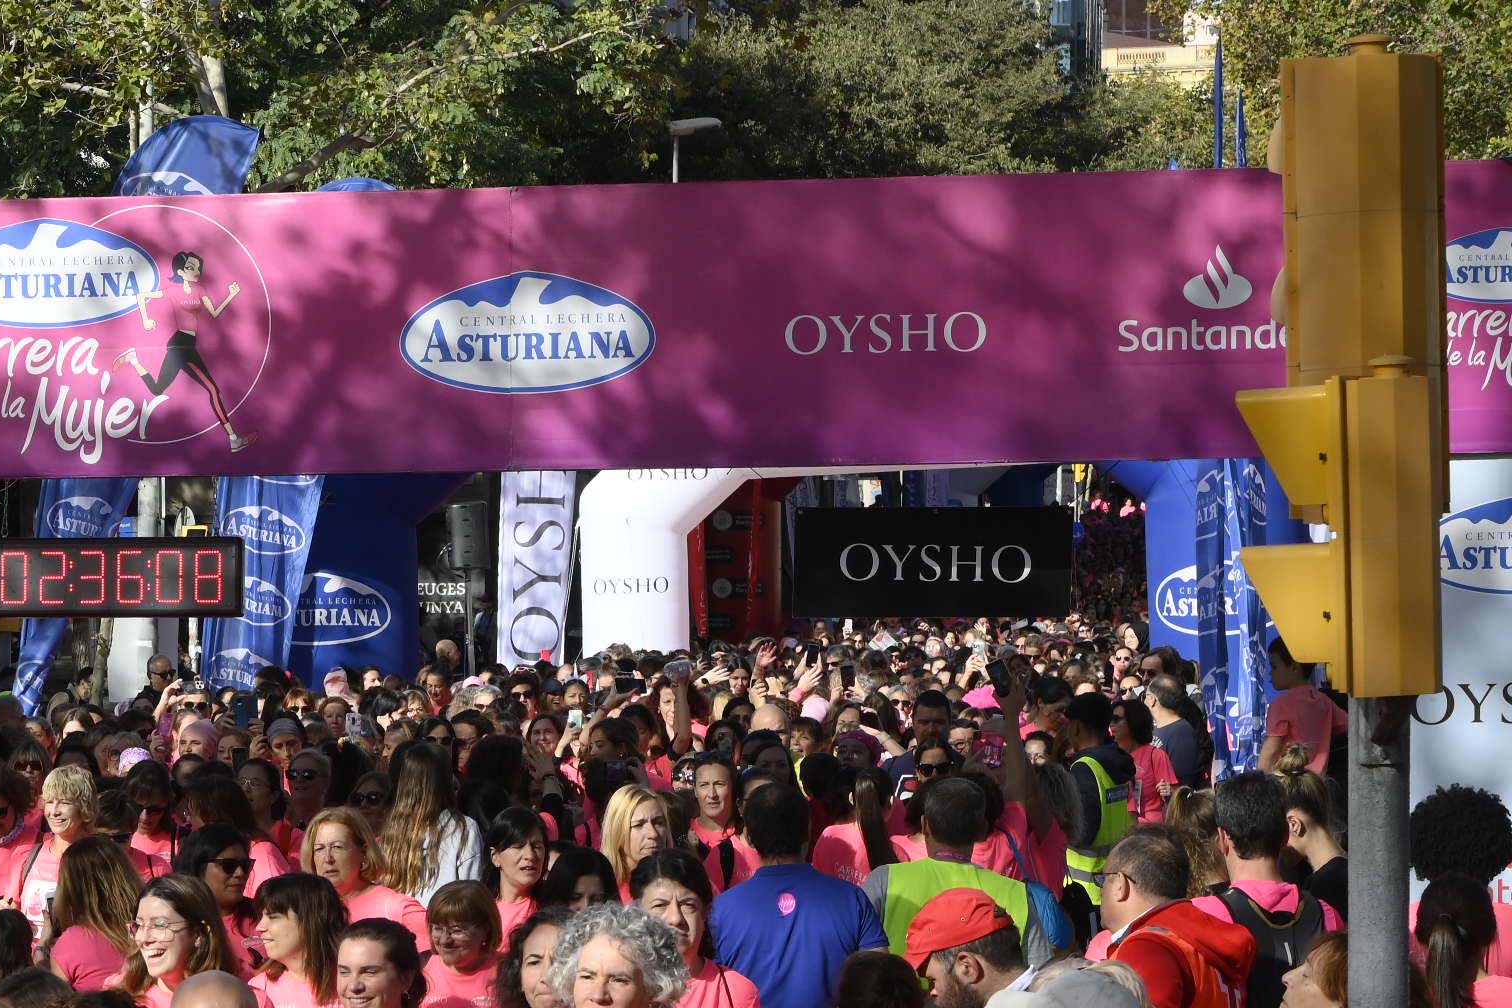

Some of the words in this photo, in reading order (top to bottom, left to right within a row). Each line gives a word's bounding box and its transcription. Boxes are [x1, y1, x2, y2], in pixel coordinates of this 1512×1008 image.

[62, 254, 136, 267] LECHERA
[459, 313, 536, 327] CENTRAL
[545, 311, 627, 325] LECHERA
[785, 311, 987, 355] OYSHO
[420, 318, 635, 364] ASTURIANA
[1468, 339, 1486, 366] la
[0, 380, 26, 419] la
[21, 366, 170, 465] Mujer
[227, 517, 297, 548] ASTURIANA
[0, 549, 223, 605] 02:36:08
[839, 542, 1031, 584] OYSHO
[593, 576, 669, 594] OYSHO
